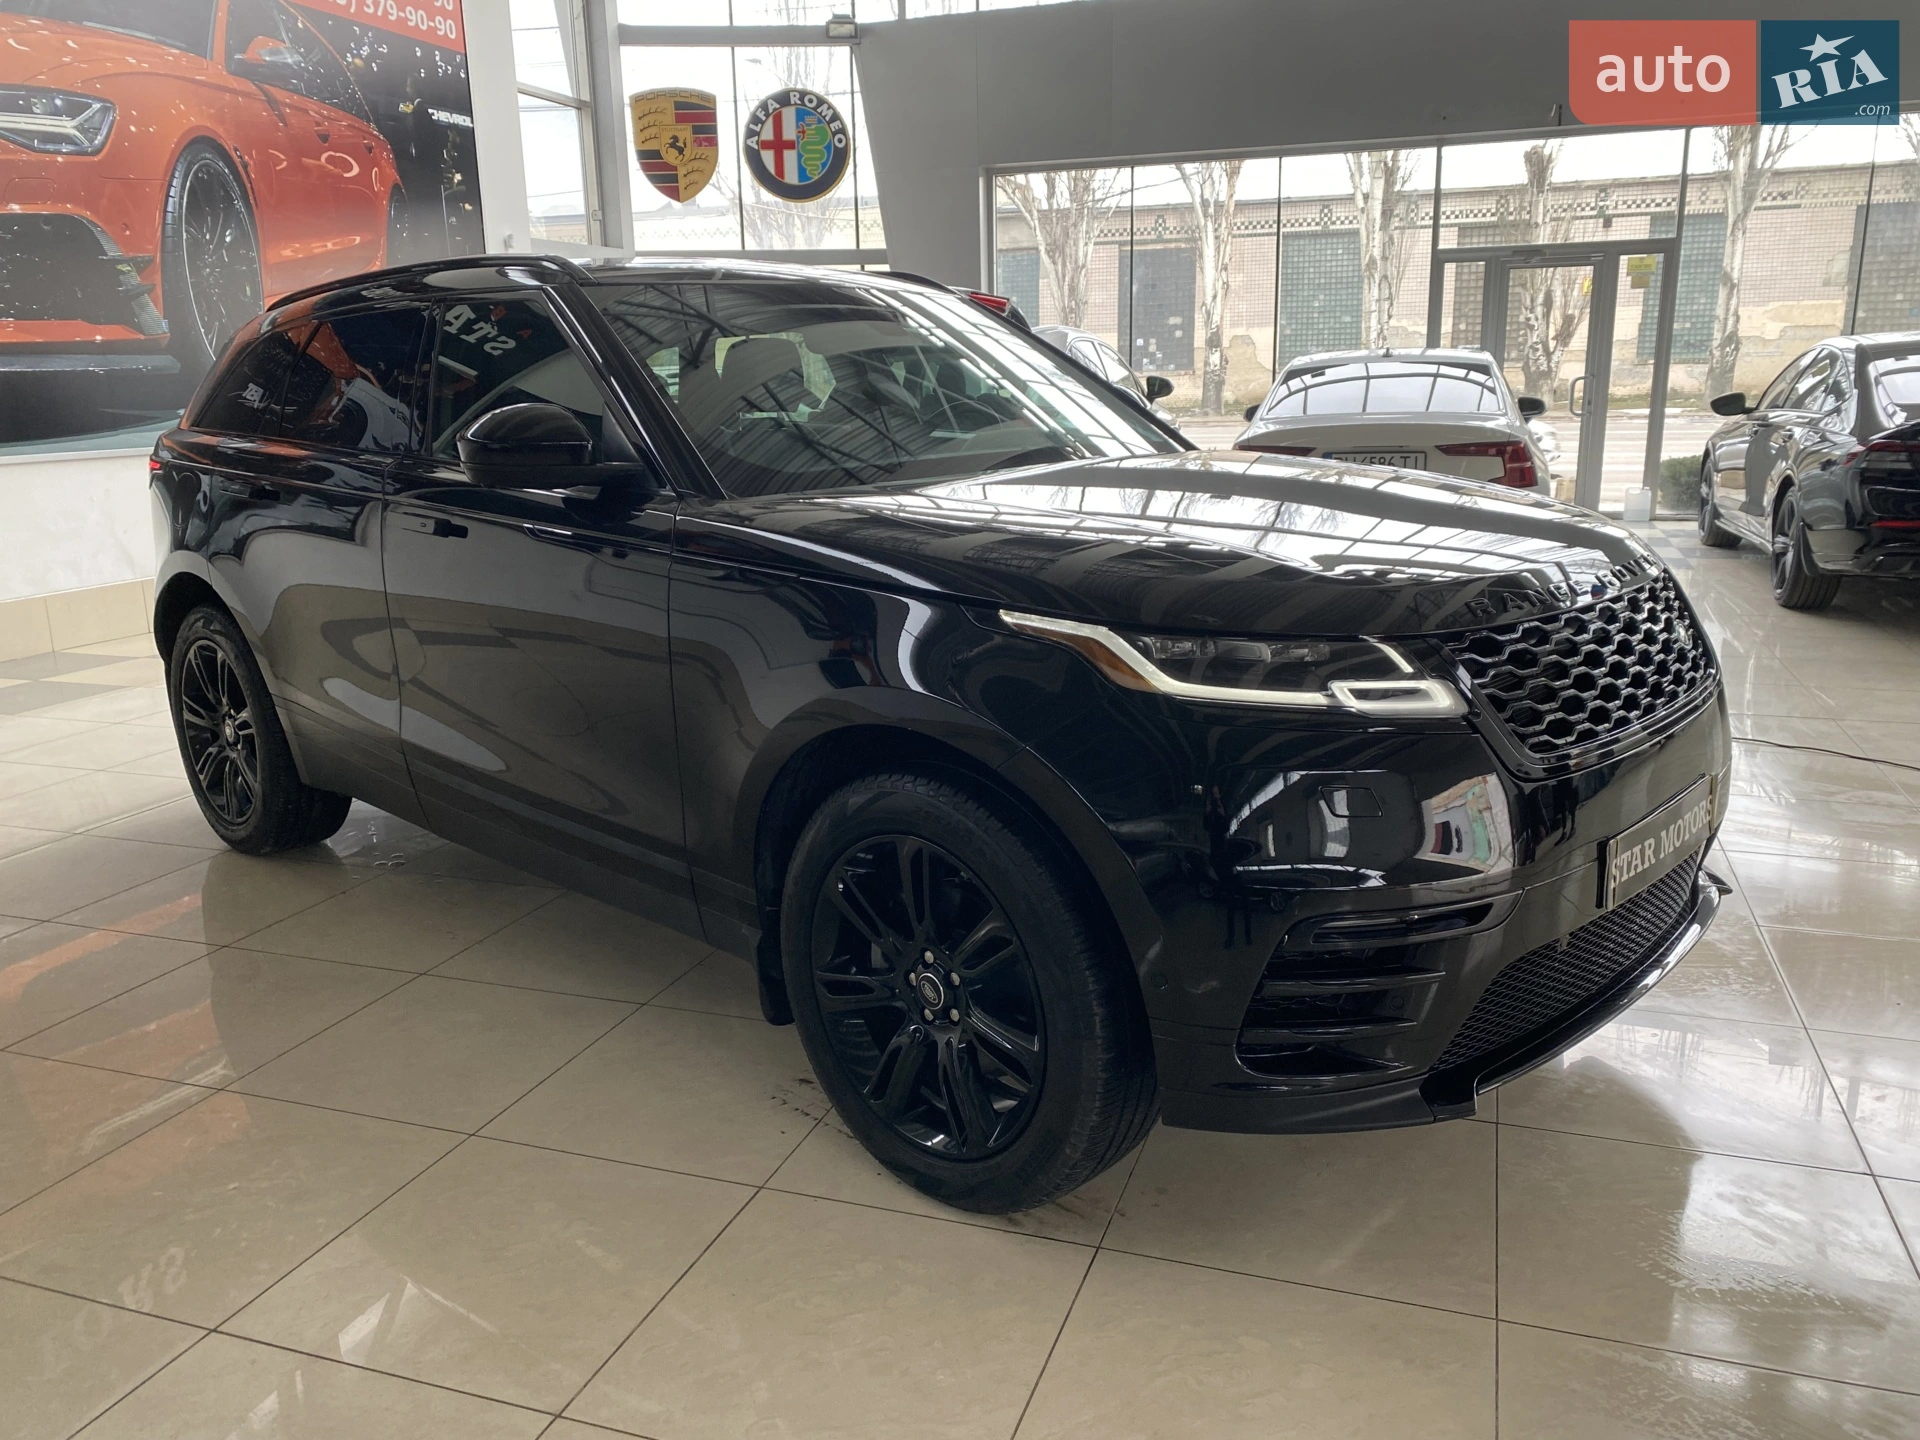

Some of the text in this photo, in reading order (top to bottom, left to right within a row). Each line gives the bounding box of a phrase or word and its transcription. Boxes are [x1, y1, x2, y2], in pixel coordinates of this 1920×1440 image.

[363, 0, 456, 39] 379-90-90
[635, 90, 712, 104] PORSCHE
[746, 91, 846, 150] ALFA ROMEO
[1465, 579, 1590, 617] RANGE
[1610, 794, 1713, 889] STAR MOTORS
